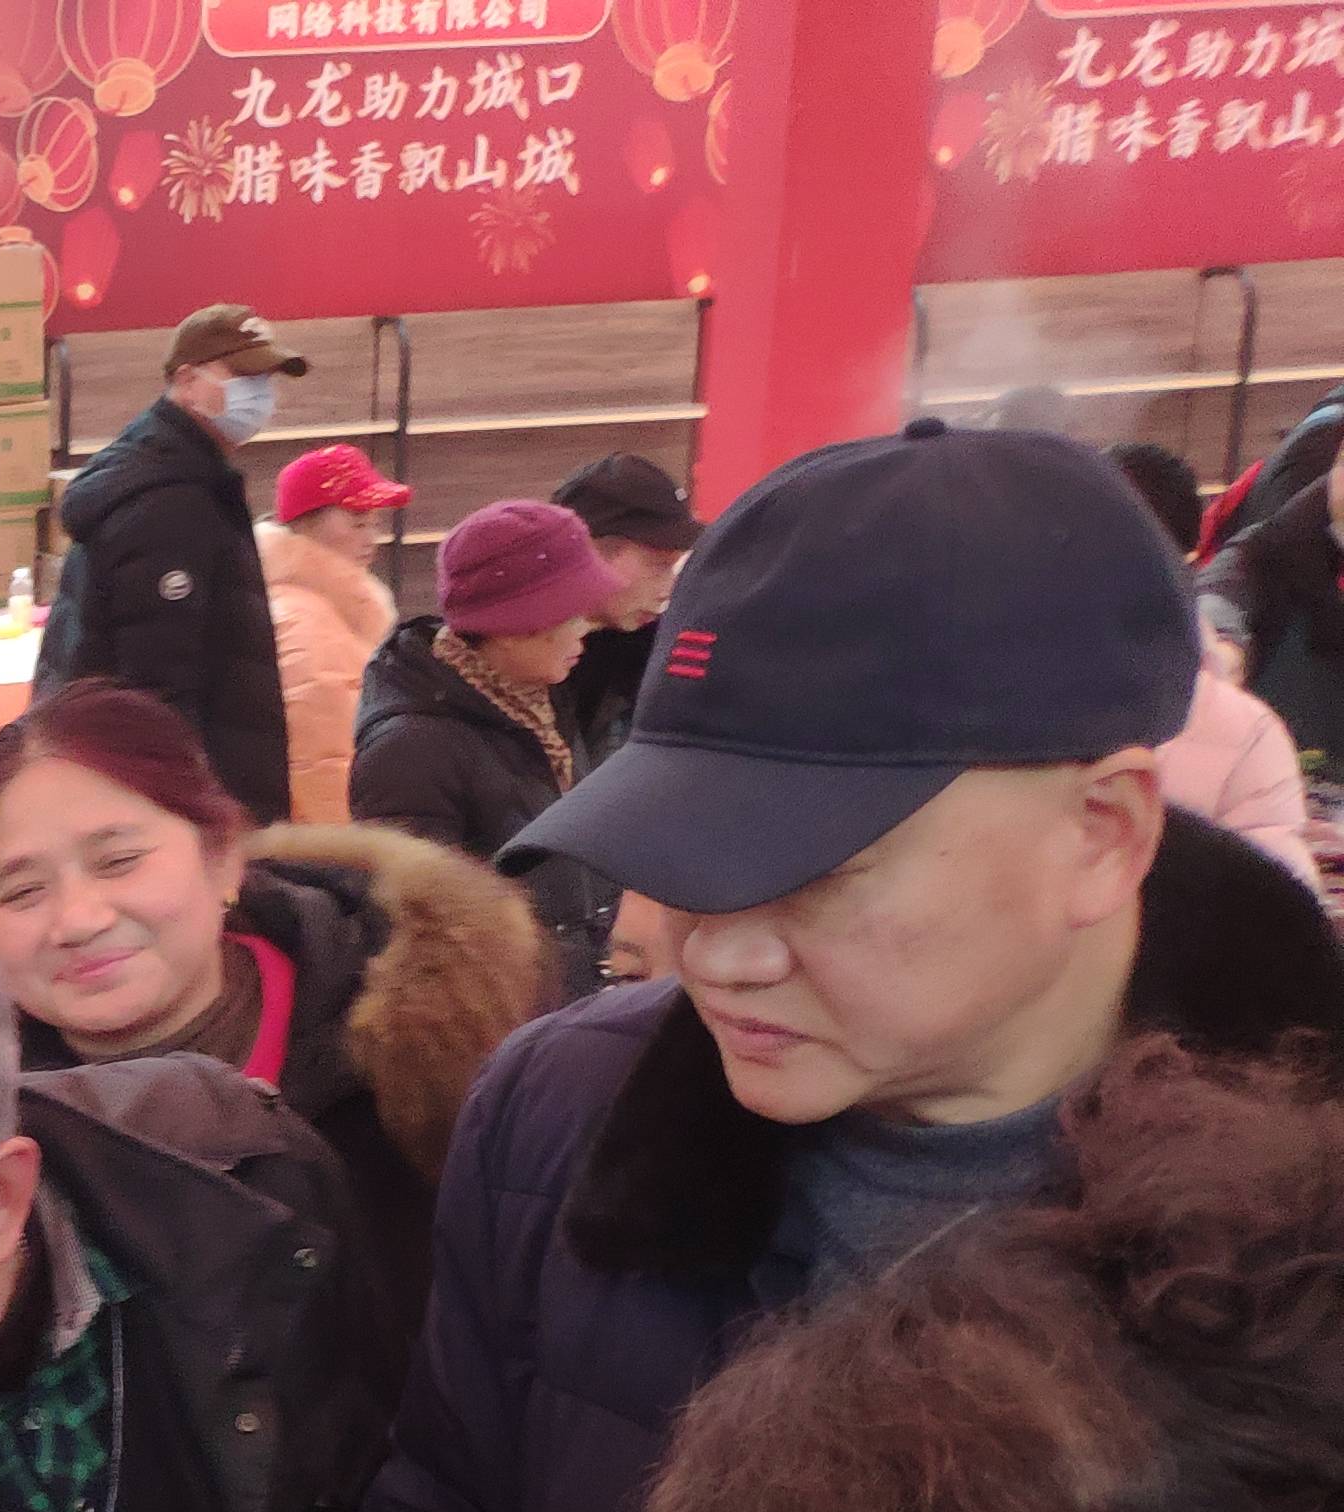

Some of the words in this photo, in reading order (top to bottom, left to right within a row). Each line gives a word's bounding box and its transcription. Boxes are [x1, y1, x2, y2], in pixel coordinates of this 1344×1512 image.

[231, 51, 584, 129] 九龙助力城口
[1042, 89, 1344, 166] 腊味香飘山
[226, 125, 582, 206] 腊味香飘山城
